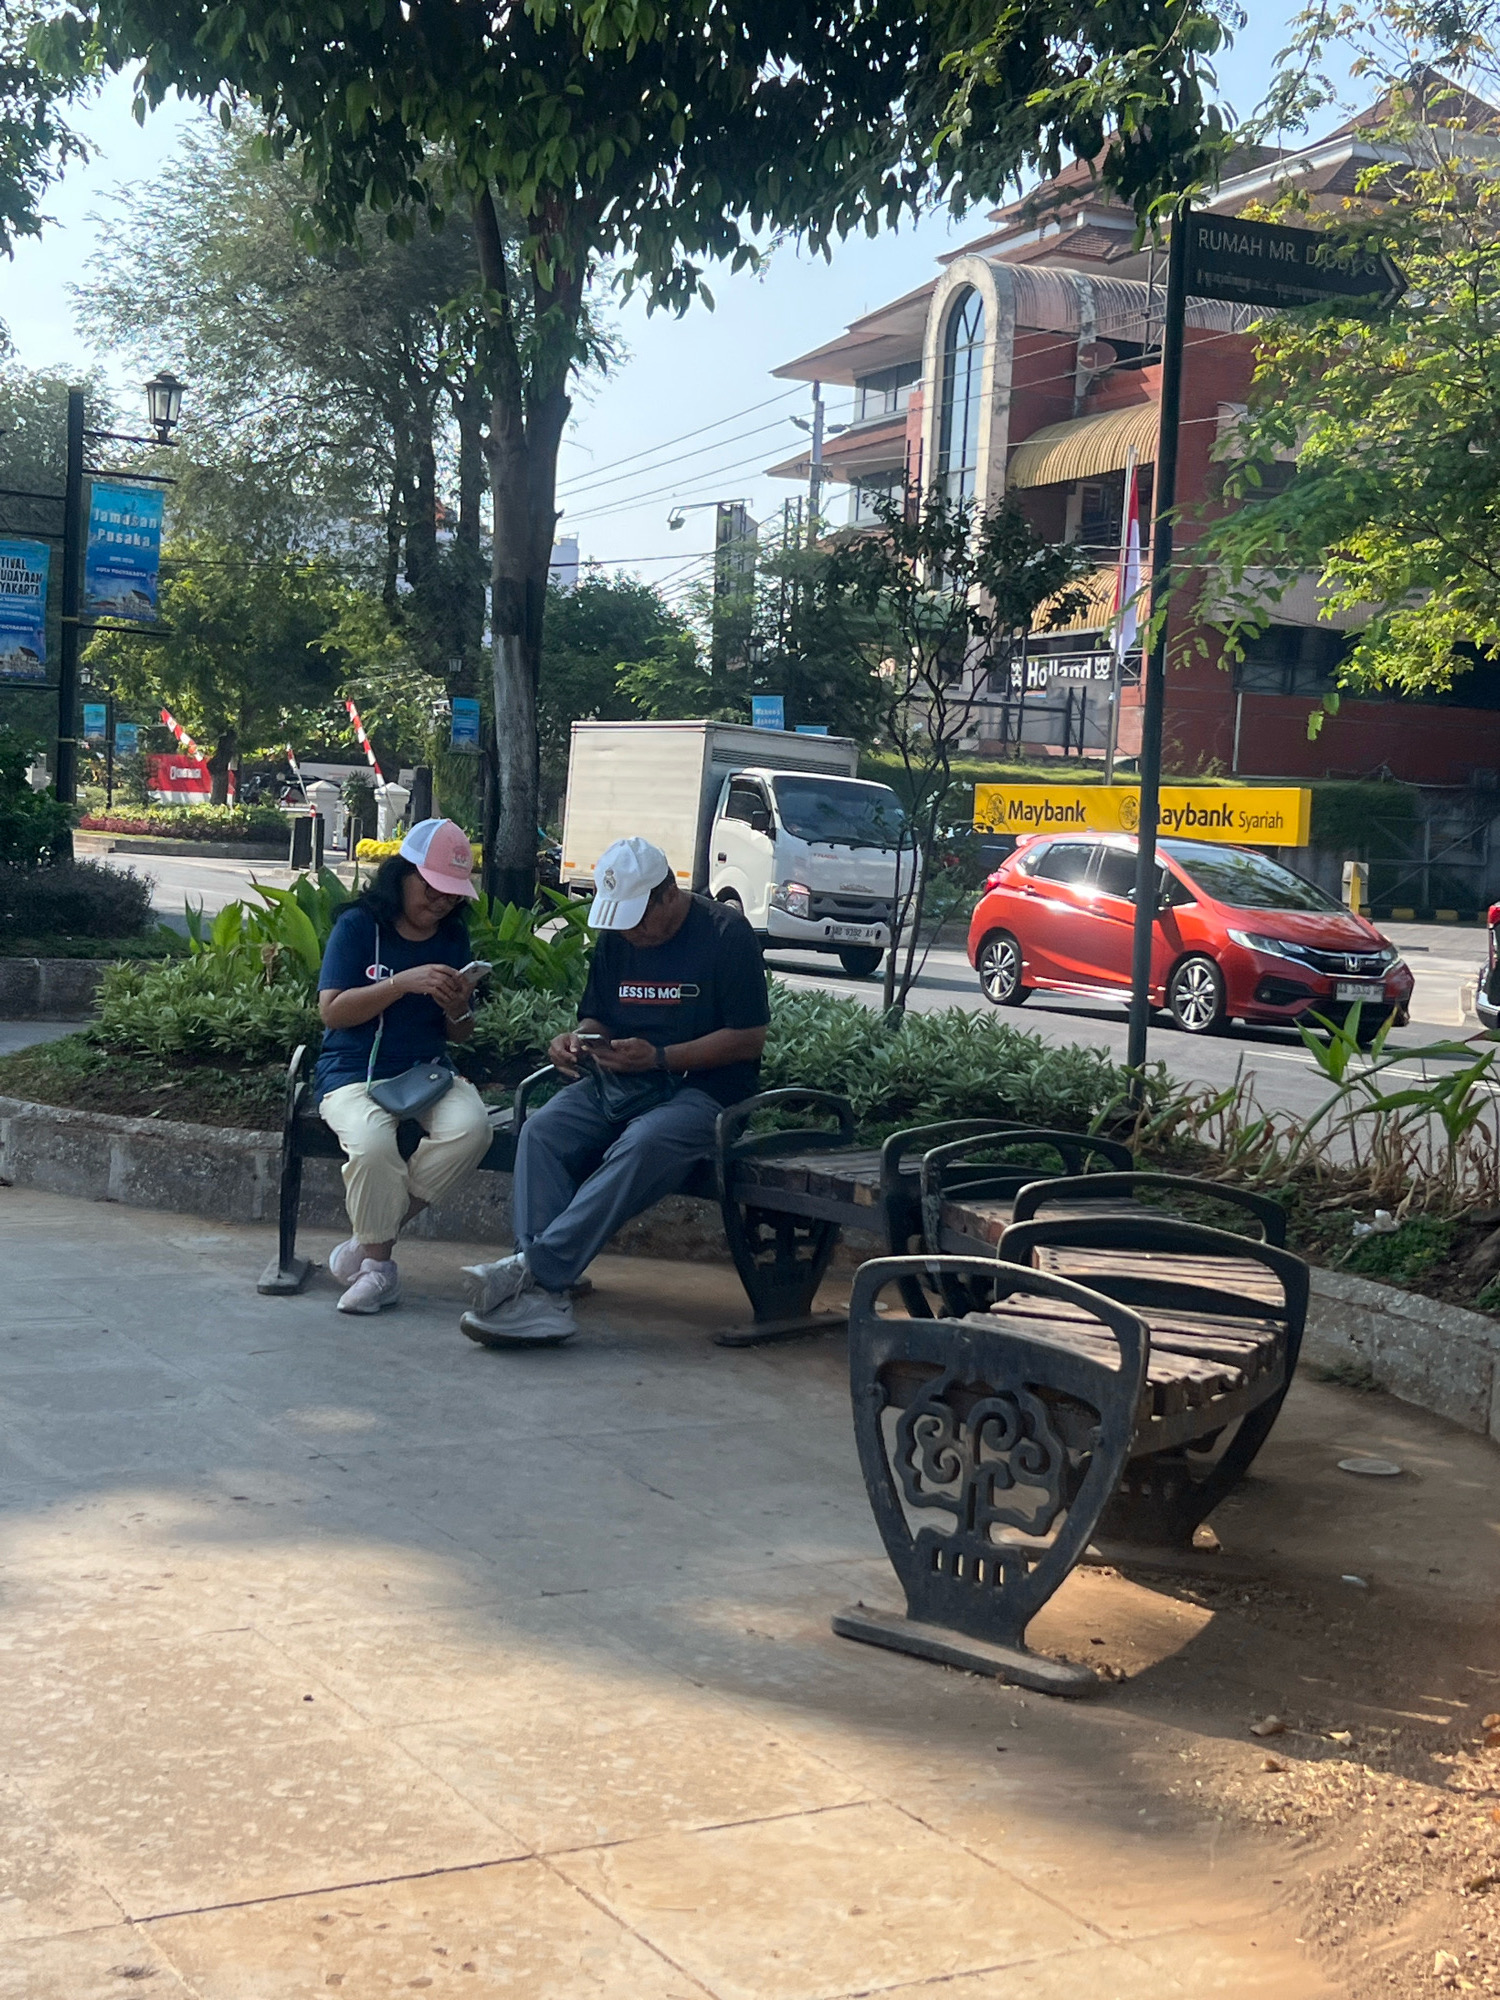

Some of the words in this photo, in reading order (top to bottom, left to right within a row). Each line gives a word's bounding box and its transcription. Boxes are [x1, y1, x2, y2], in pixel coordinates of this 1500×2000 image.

[1198, 228, 1263, 257] RUMAH
[97, 528, 151, 547] Pusaka
[1026, 657, 1092, 687] Holland
[1008, 799, 1087, 827] Maybank
[1157, 803, 1233, 832] aybank
[1238, 810, 1284, 833] Syariah
[618, 985, 643, 998] LESS
[644, 986, 656, 999] IS
